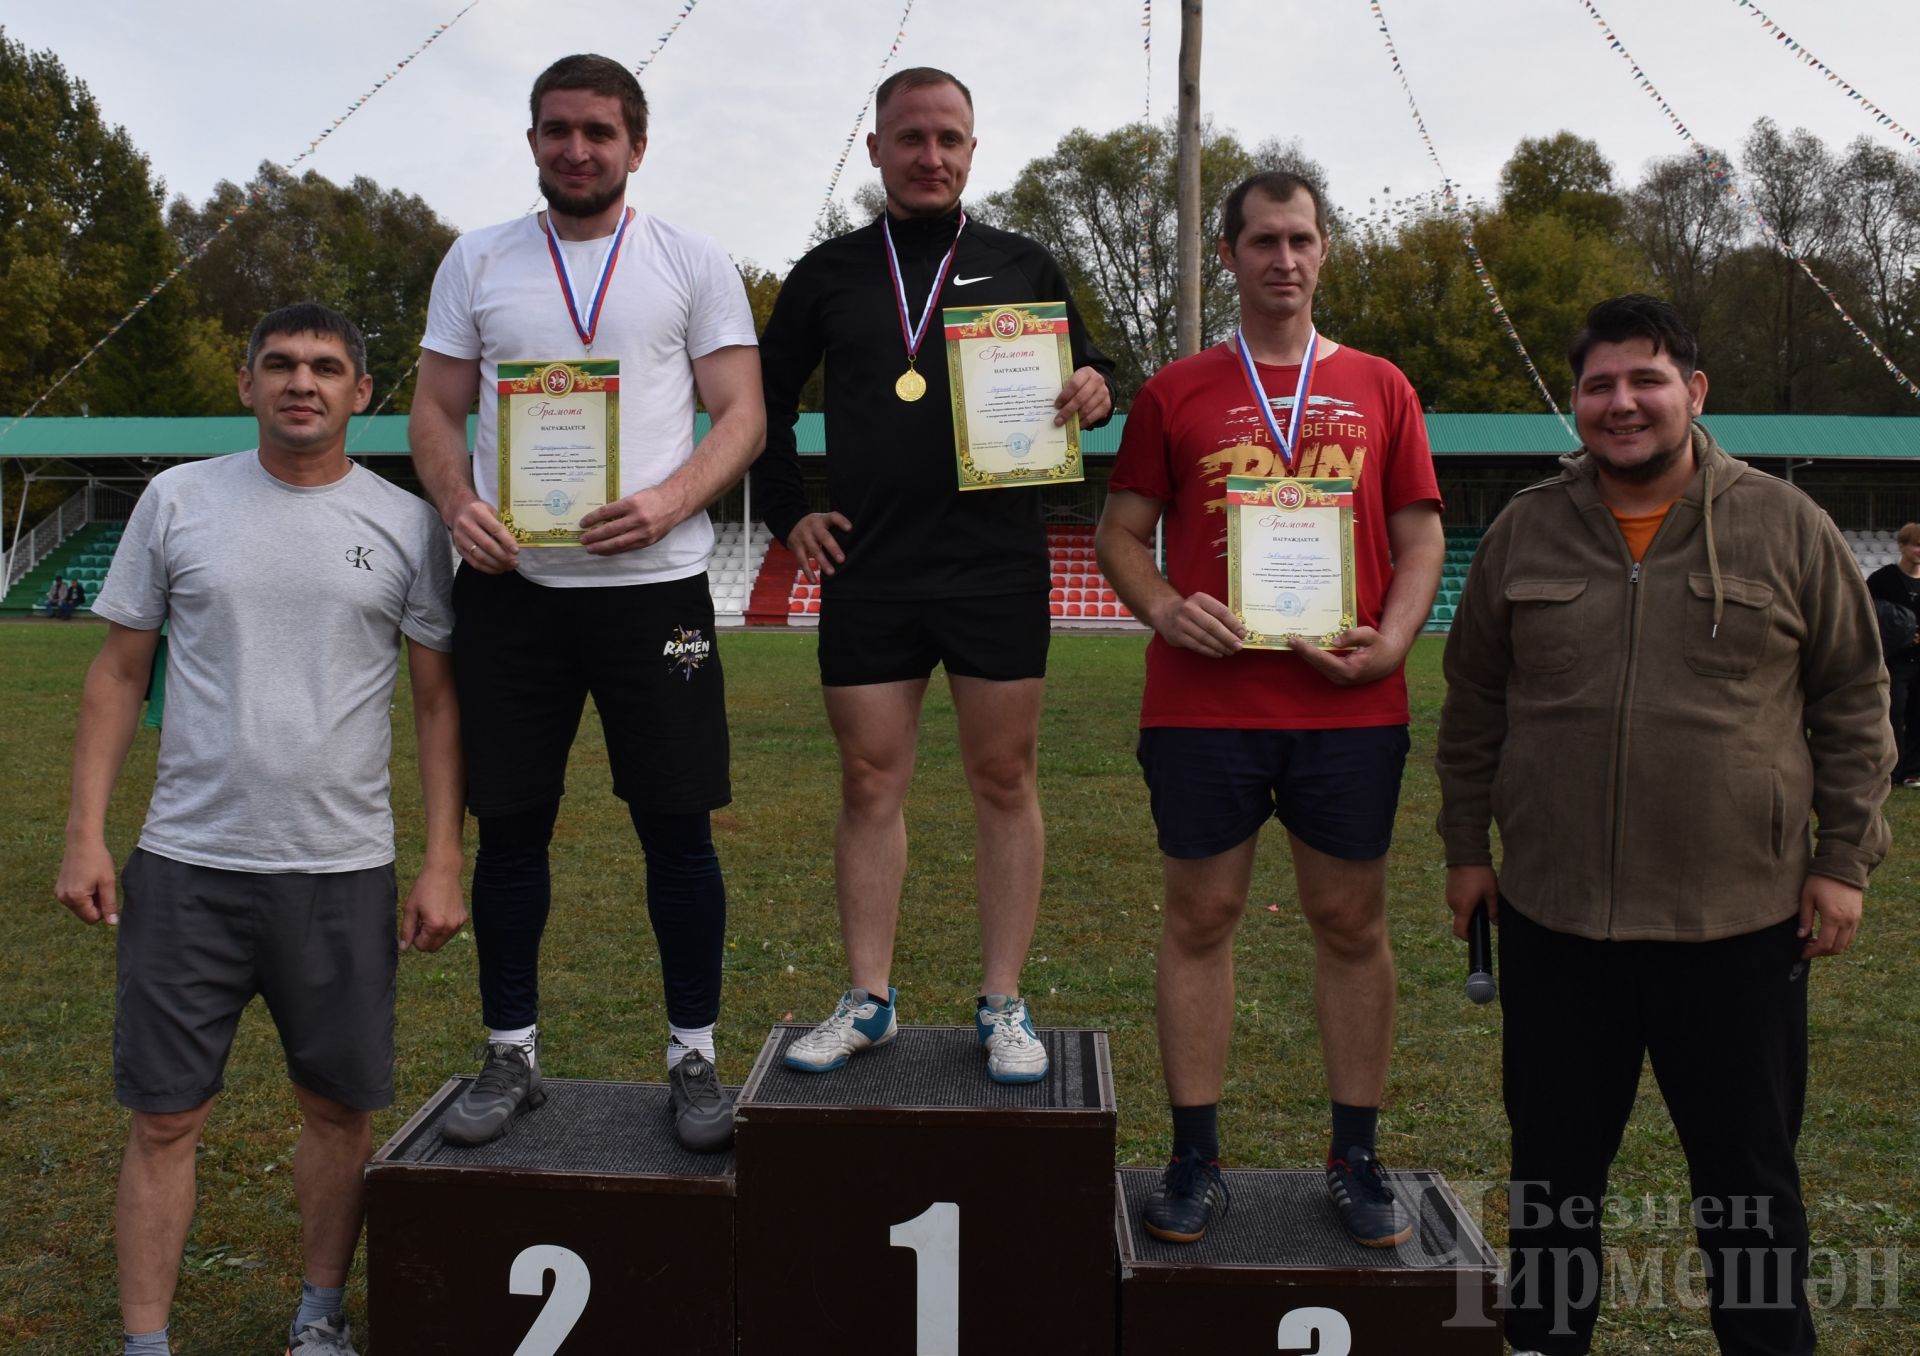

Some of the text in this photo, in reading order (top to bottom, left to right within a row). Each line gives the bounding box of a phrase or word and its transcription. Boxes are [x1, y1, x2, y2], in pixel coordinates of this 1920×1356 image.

[979, 345, 1035, 363] Грамота
[994, 366, 1040, 374] НАГРАЖДАЕТСЯ
[528, 402, 583, 420] Грамота
[1302, 422, 1367, 440] BETTER
[1259, 514, 1316, 531] Грамота
[663, 640, 710, 656] RAMEN
[890, 1202, 959, 1356] 1
[509, 1244, 591, 1356] 2
